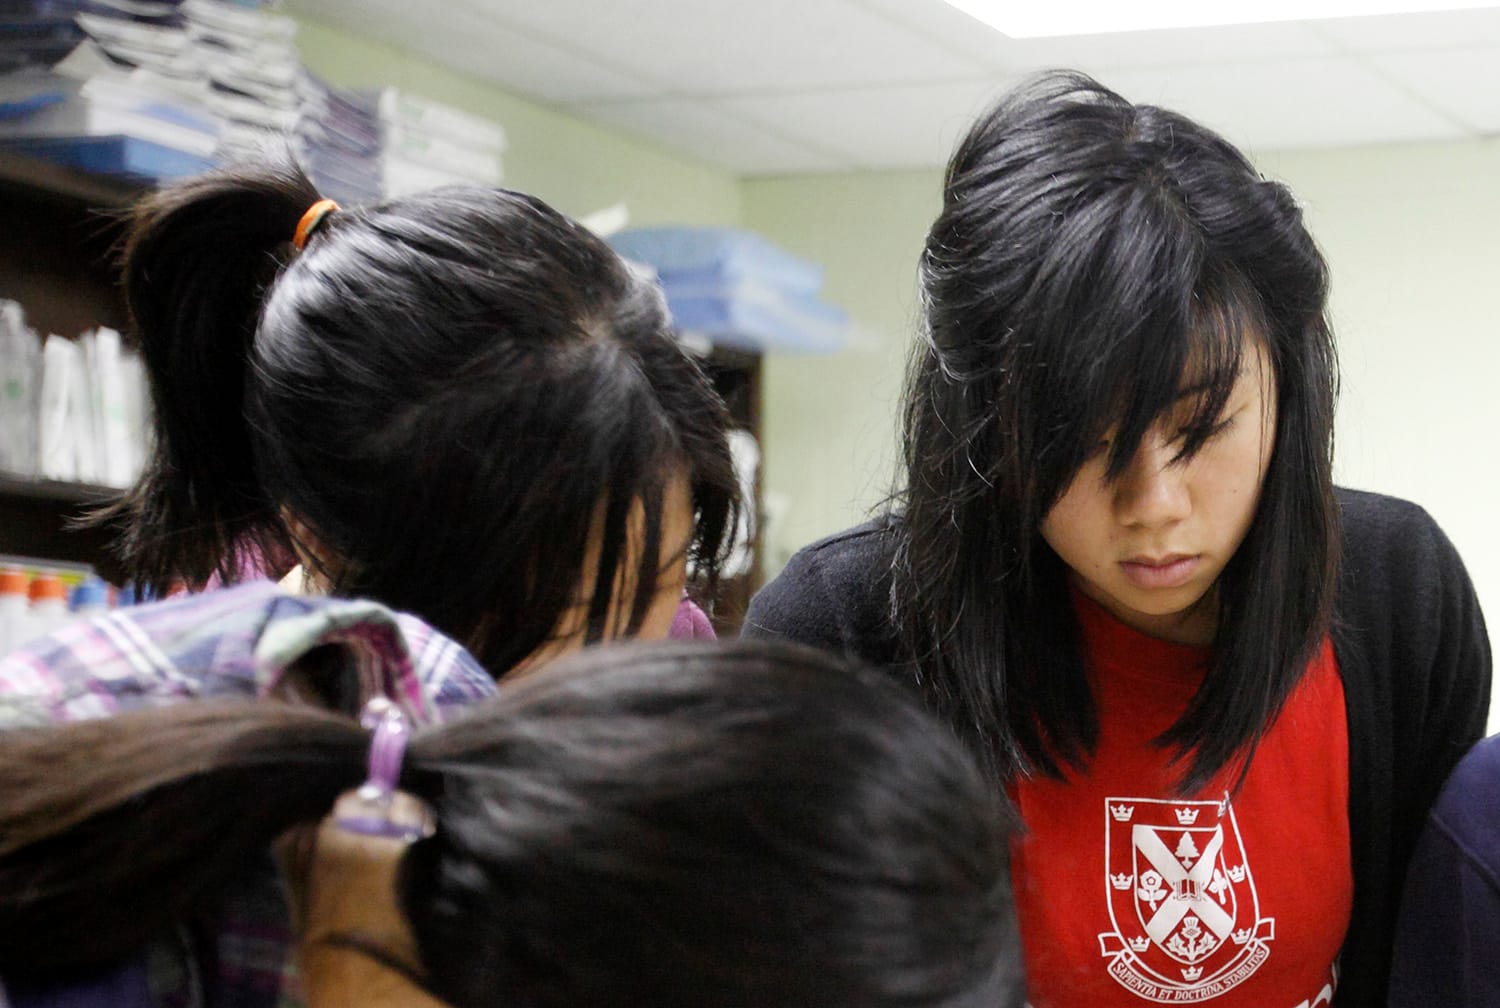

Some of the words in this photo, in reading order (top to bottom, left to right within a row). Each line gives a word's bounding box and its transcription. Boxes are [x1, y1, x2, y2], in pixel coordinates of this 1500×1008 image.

[1112, 962, 1157, 997] SAPIENTIA
[1158, 990, 1173, 1000] ET
[1174, 982, 1224, 1000] DOCTRINA
[1223, 948, 1266, 988] STABILITAS
